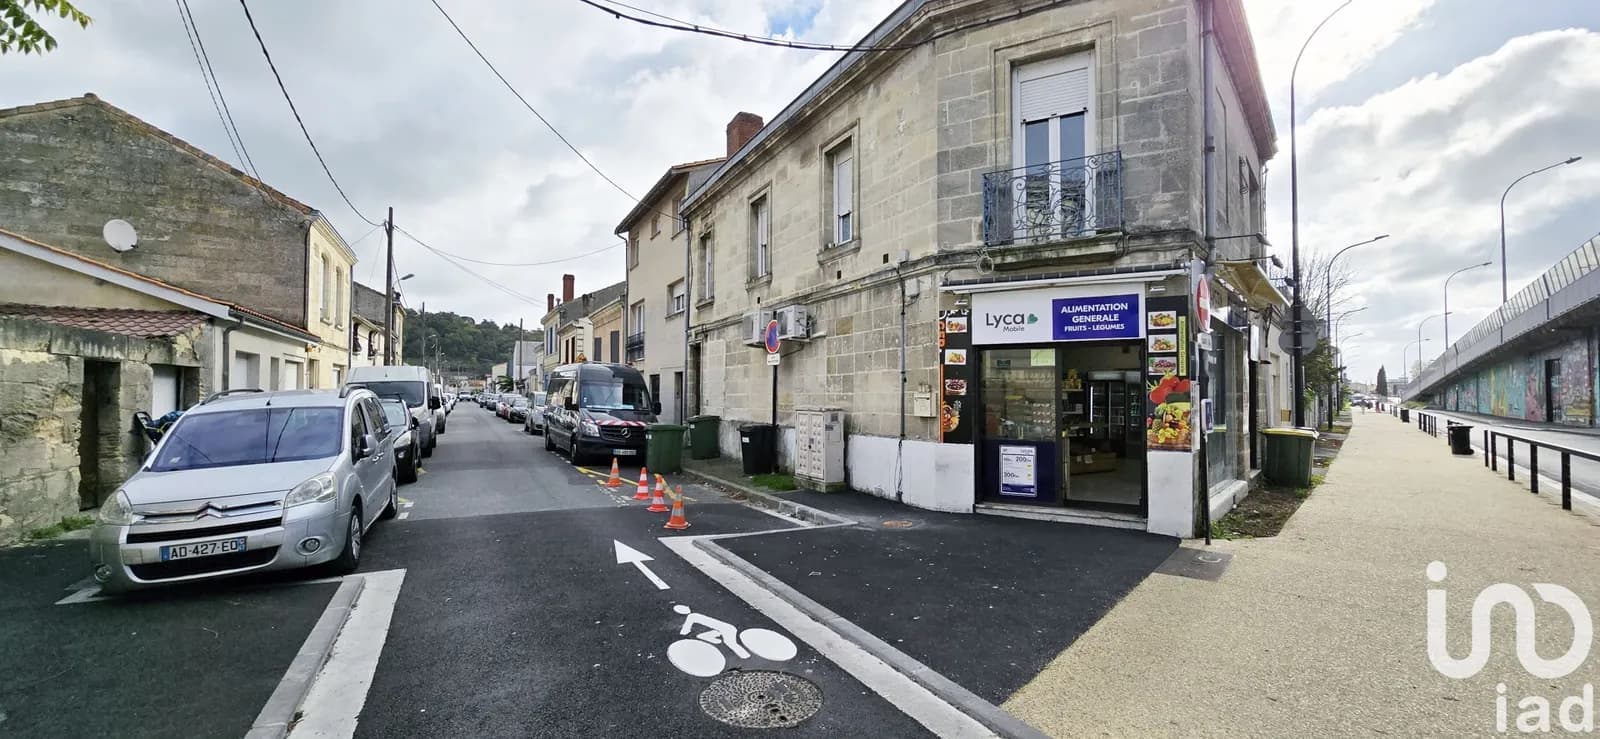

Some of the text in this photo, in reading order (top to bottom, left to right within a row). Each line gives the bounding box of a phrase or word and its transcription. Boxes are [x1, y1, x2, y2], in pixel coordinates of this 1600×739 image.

[1060, 303, 1128, 313] ALIMENTATION
[986, 313, 1025, 328] Lyca
[1072, 314, 1119, 323] GENERALE
[1092, 323, 1125, 331] LEGUMES
